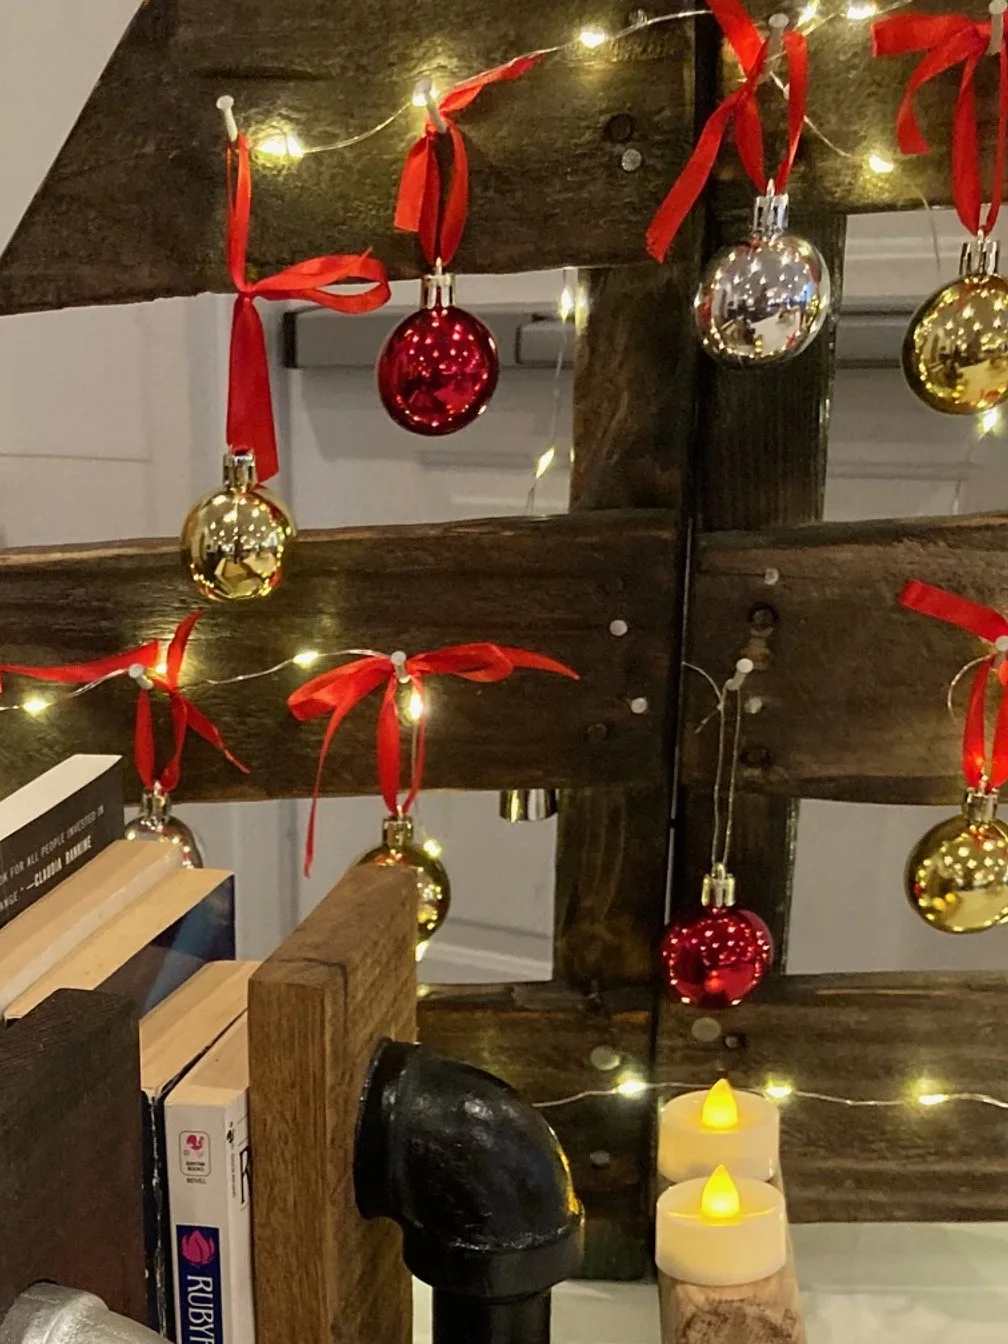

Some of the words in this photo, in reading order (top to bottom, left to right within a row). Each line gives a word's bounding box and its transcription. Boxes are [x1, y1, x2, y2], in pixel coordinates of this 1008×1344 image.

[10, 860, 25, 878] FOR
[26, 851, 40, 869] ALL
[41, 831, 65, 857] PEOPLE
[66, 811, 96, 839] INVESTED
[97, 804, 105, 818] IN
[65, 835, 92, 865] RANKINE
